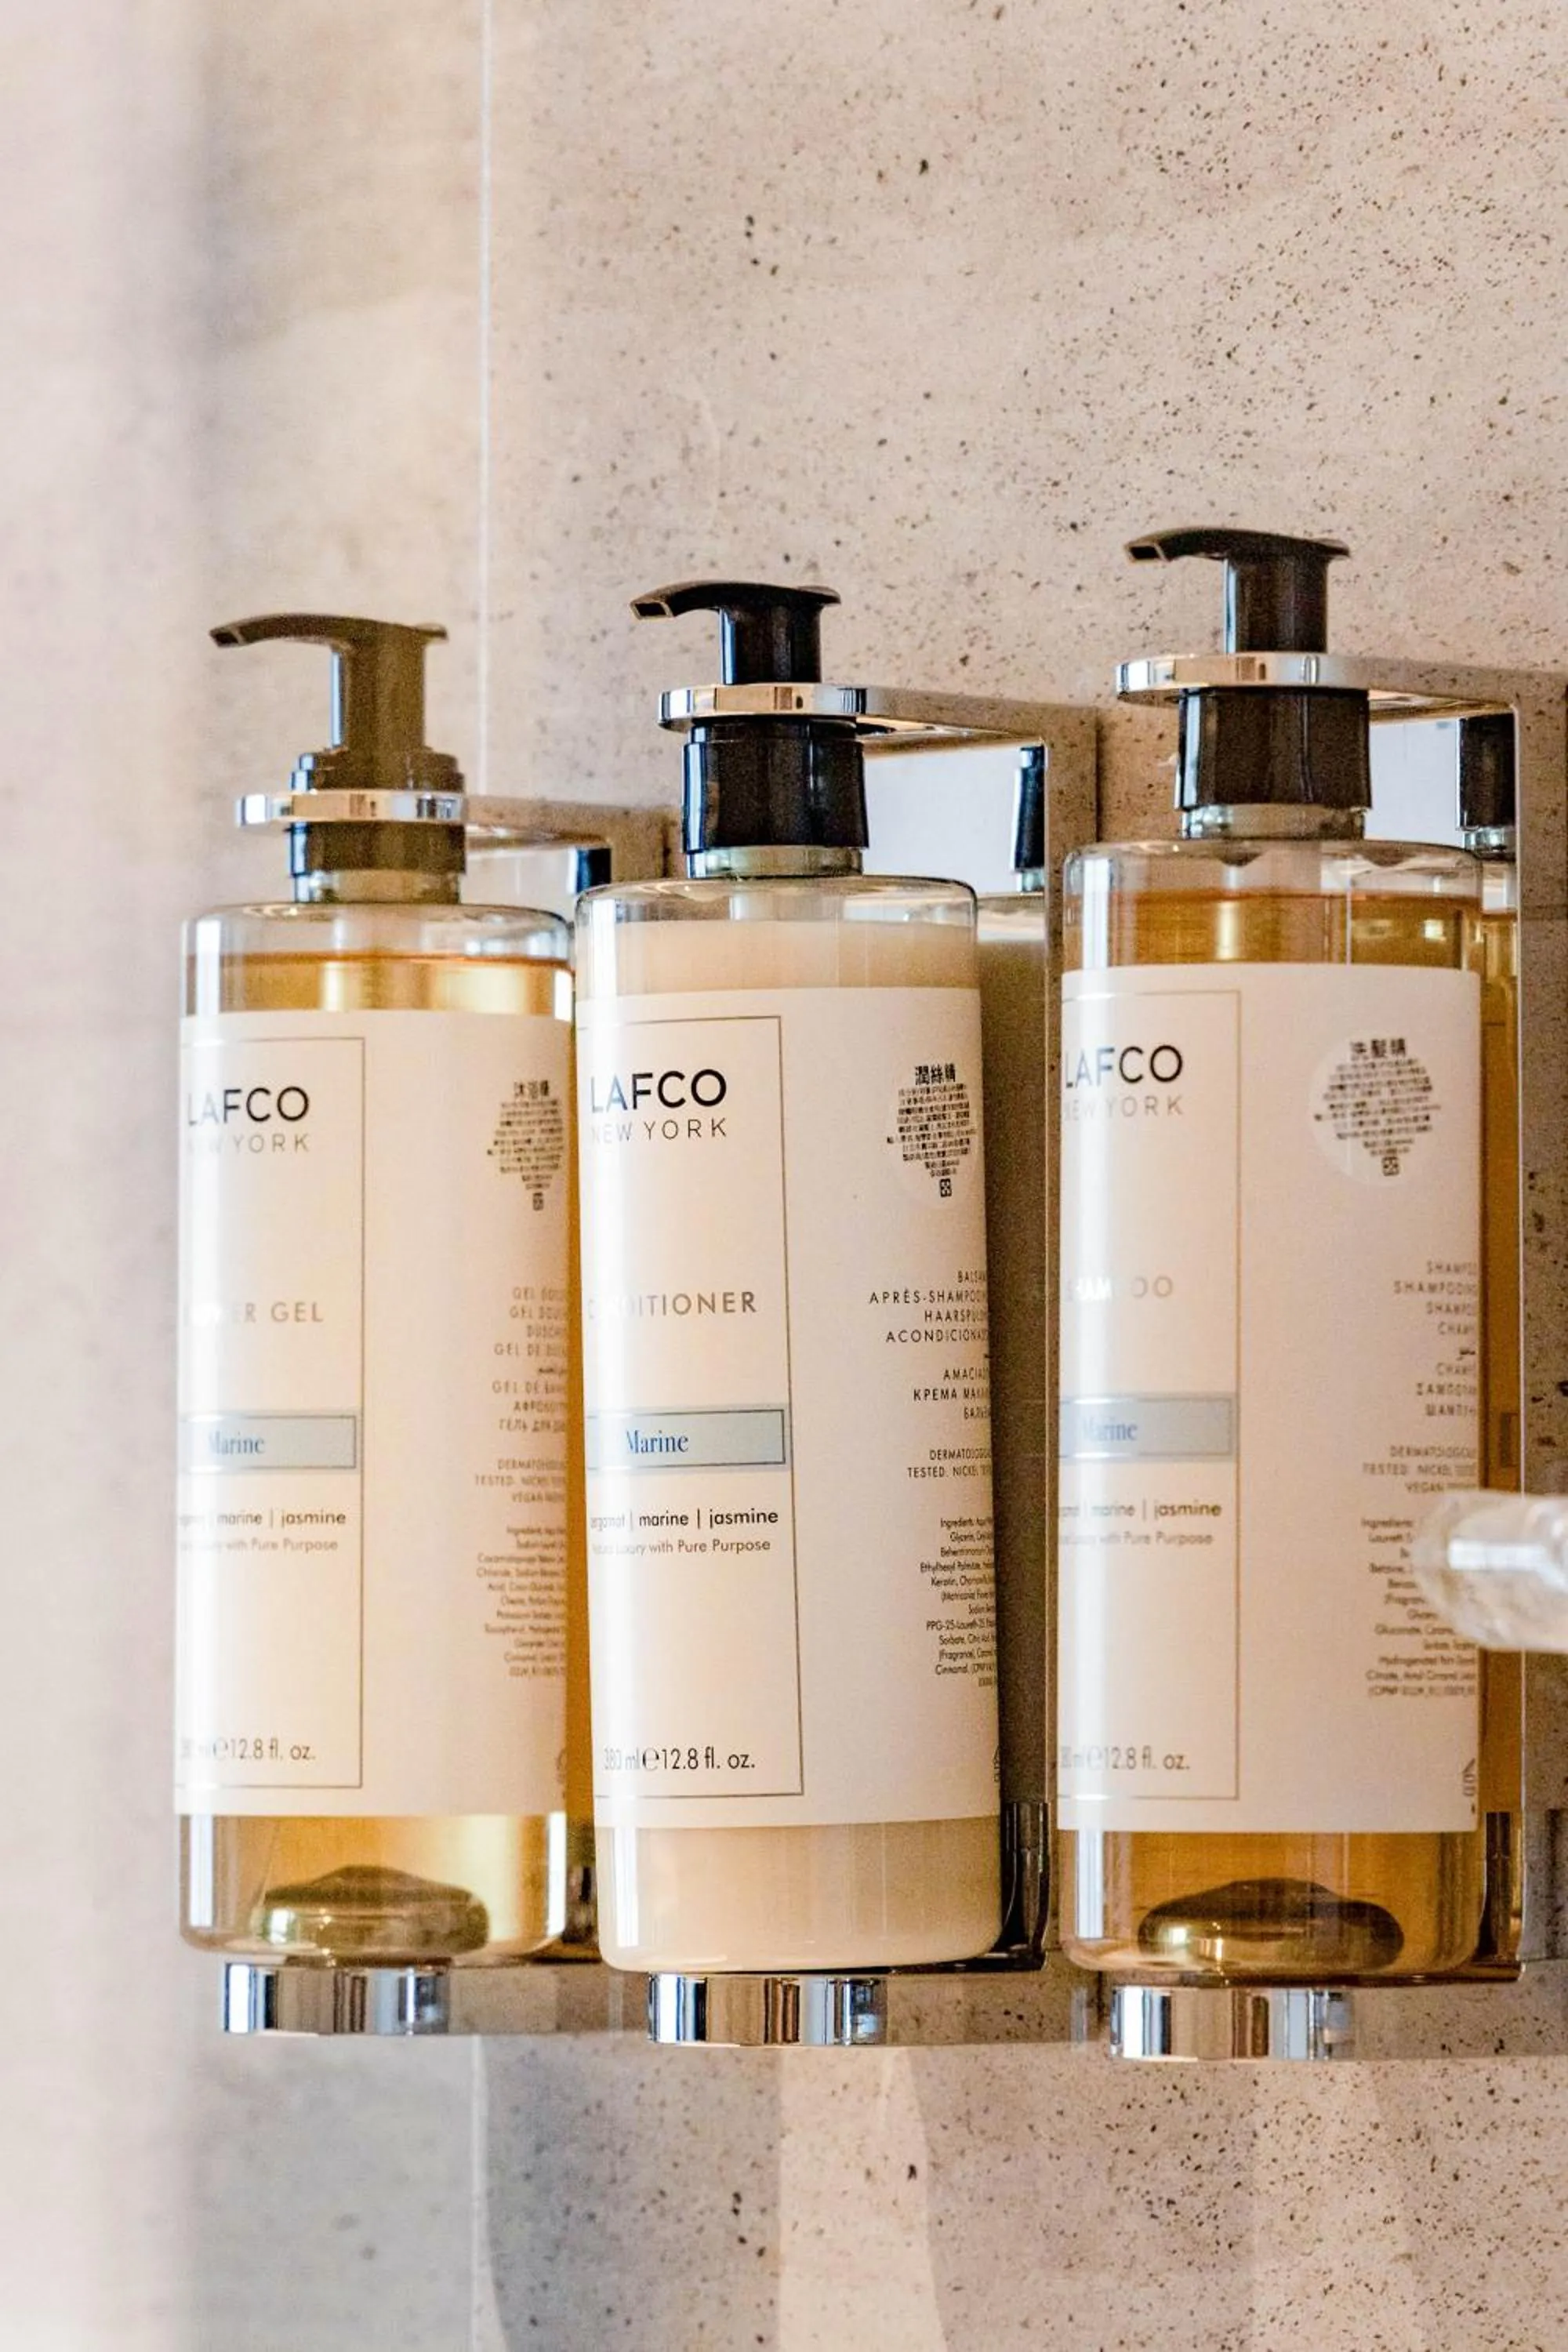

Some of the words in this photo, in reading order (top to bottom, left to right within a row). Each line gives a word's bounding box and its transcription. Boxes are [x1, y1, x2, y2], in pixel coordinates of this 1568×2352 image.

[1065, 1044, 1185, 1088] LAFCO
[590, 1069, 728, 1114] LAFCO
[187, 1086, 310, 1126] LAFCO
[1106, 1094, 1185, 1118] YORK
[643, 1116, 728, 1142] YORK
[232, 1134, 311, 1156] YORK
[270, 1300, 325, 1323] GEL
[626, 1430, 690, 1456] Marine
[217, 1510, 263, 1526] marine
[281, 1508, 347, 1530] jasmine
[638, 1510, 691, 1530] marine
[708, 1507, 780, 1530] jasmine
[1153, 1498, 1223, 1521] jasmine
[282, 1537, 339, 1555] Purpose
[648, 1538, 673, 1555] with
[677, 1537, 707, 1555] Pure
[712, 1535, 772, 1555] Purpose
[290, 1743, 317, 1762] oz.
[703, 1744, 721, 1770] fl.
[727, 1752, 757, 1770] oz.
[1163, 1752, 1191, 1771] oz.
